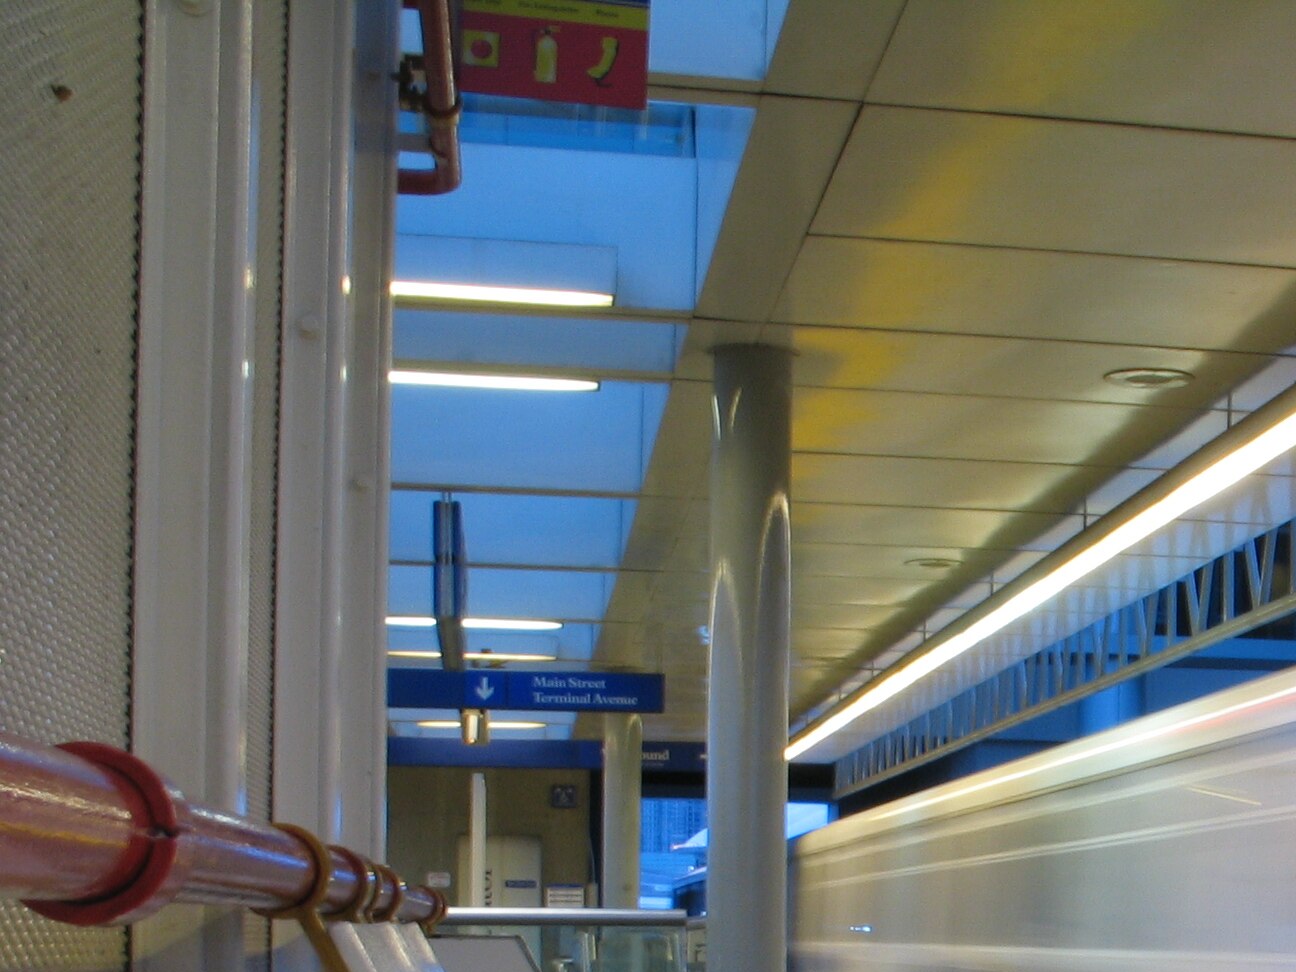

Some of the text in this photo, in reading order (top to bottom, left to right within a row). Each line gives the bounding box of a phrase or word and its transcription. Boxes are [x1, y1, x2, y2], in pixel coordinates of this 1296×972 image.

[533, 676, 606, 689] Main Street
[532, 692, 638, 706] Terminal Avenue
